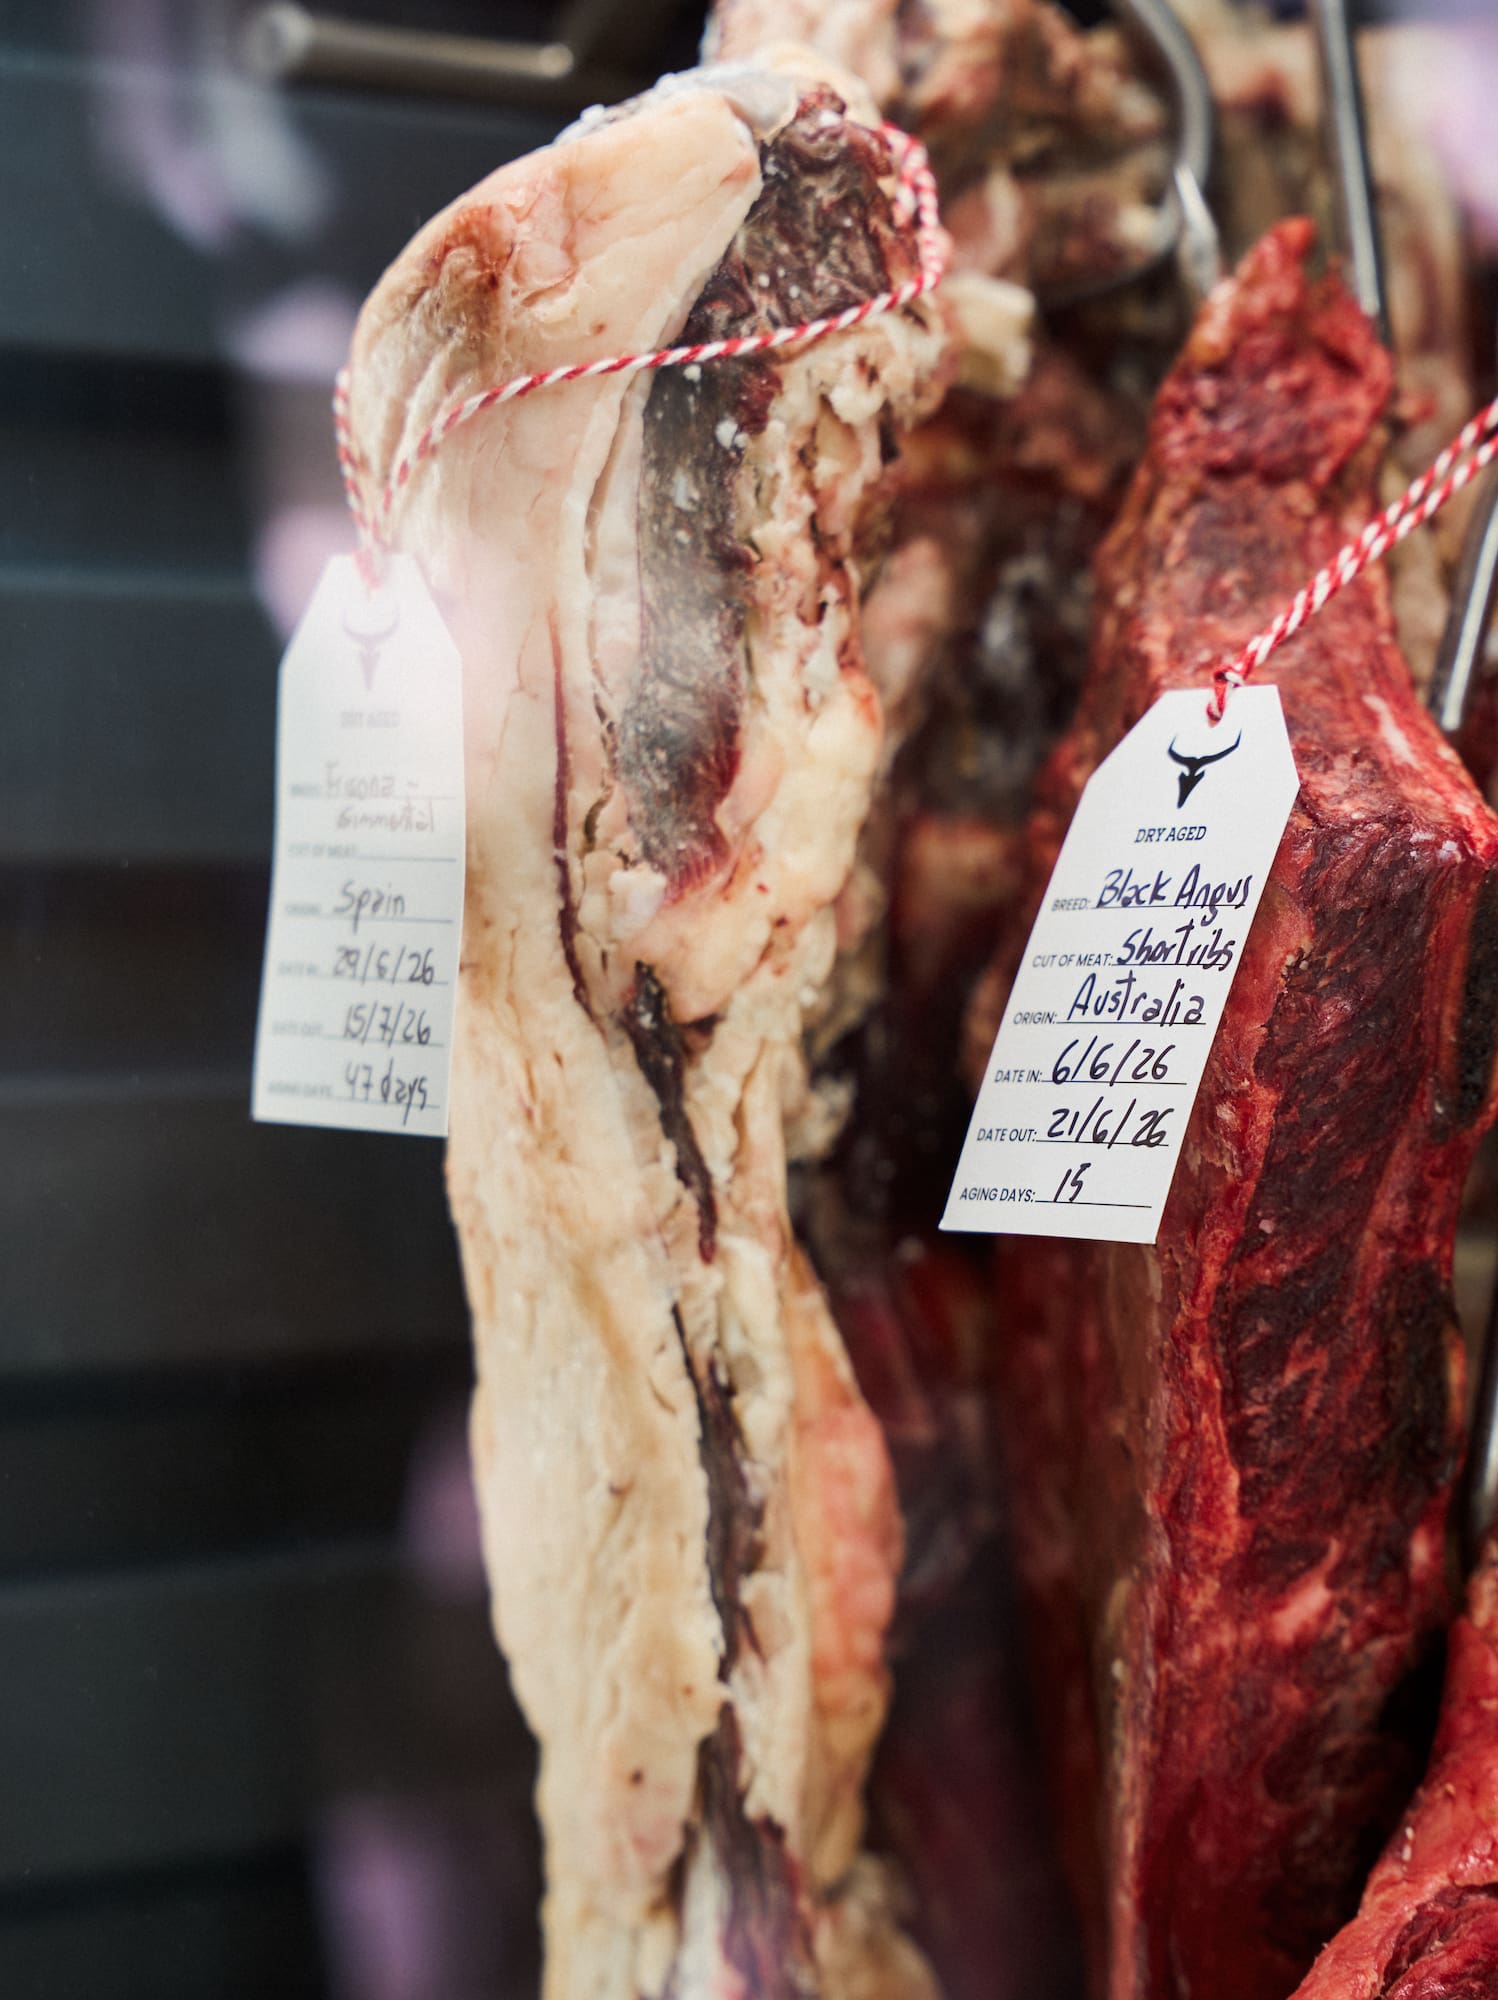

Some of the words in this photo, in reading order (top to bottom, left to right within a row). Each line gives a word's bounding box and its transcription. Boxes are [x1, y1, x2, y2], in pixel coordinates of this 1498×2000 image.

[1134, 828, 1166, 843] DRY
[1169, 826, 1207, 842] AGED
[334, 879, 405, 934] Spain
[1051, 898, 1091, 912] BREED:
[1095, 868, 1172, 908] Black
[1174, 863, 1253, 926] Angus
[1032, 954, 1056, 968] CUT
[1058, 954, 1073, 968] OF
[1075, 953, 1114, 967] MEAT:
[343, 1001, 431, 1047] 15/7/26
[1013, 1011, 1058, 1025] ORIGIN:
[1066, 969, 1205, 1027] Australia
[994, 1069, 1023, 1083] DATE
[1024, 1069, 1043, 1082] IN:
[1051, 1035, 1176, 1087] 6/6/26
[344, 1061, 374, 1102] 47
[381, 1056, 427, 1127] days
[976, 1128, 1006, 1142] DATE
[1008, 1128, 1037, 1142] OUT:
[1046, 1096, 1175, 1149] 21/6/26
[959, 1187, 998, 1201] AGING
[999, 1188, 1036, 1203] DAYS:
